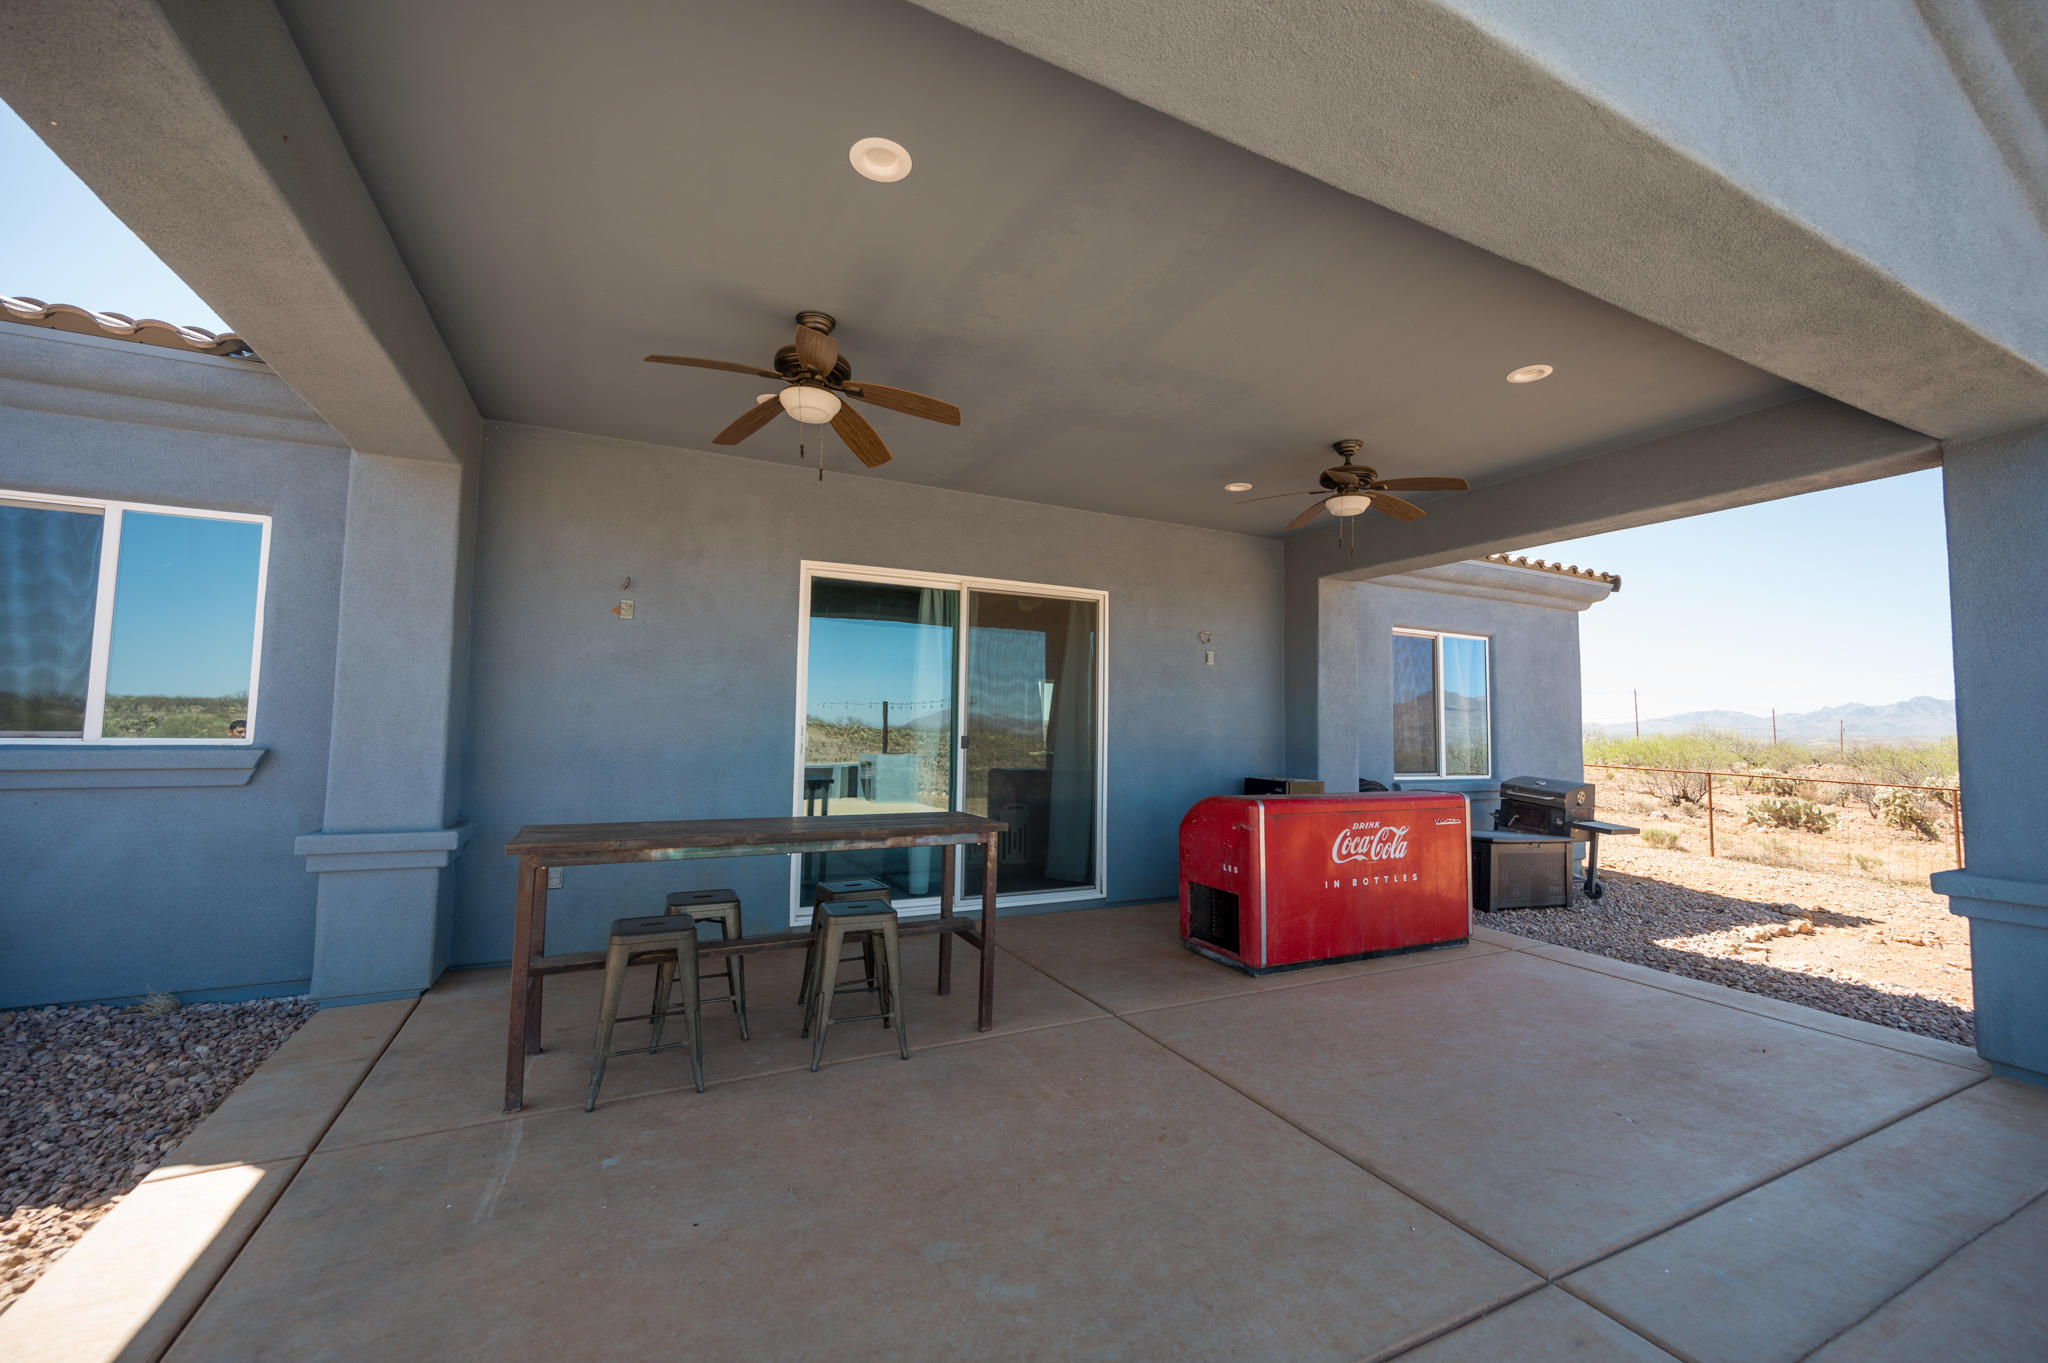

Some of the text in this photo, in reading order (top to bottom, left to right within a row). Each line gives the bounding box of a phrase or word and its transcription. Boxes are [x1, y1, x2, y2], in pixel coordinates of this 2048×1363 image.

[1352, 821, 1380, 830] DRINK
[1332, 825, 1409, 864] Coca-Cola
[1324, 873, 1418, 889] IN BOTTLES
